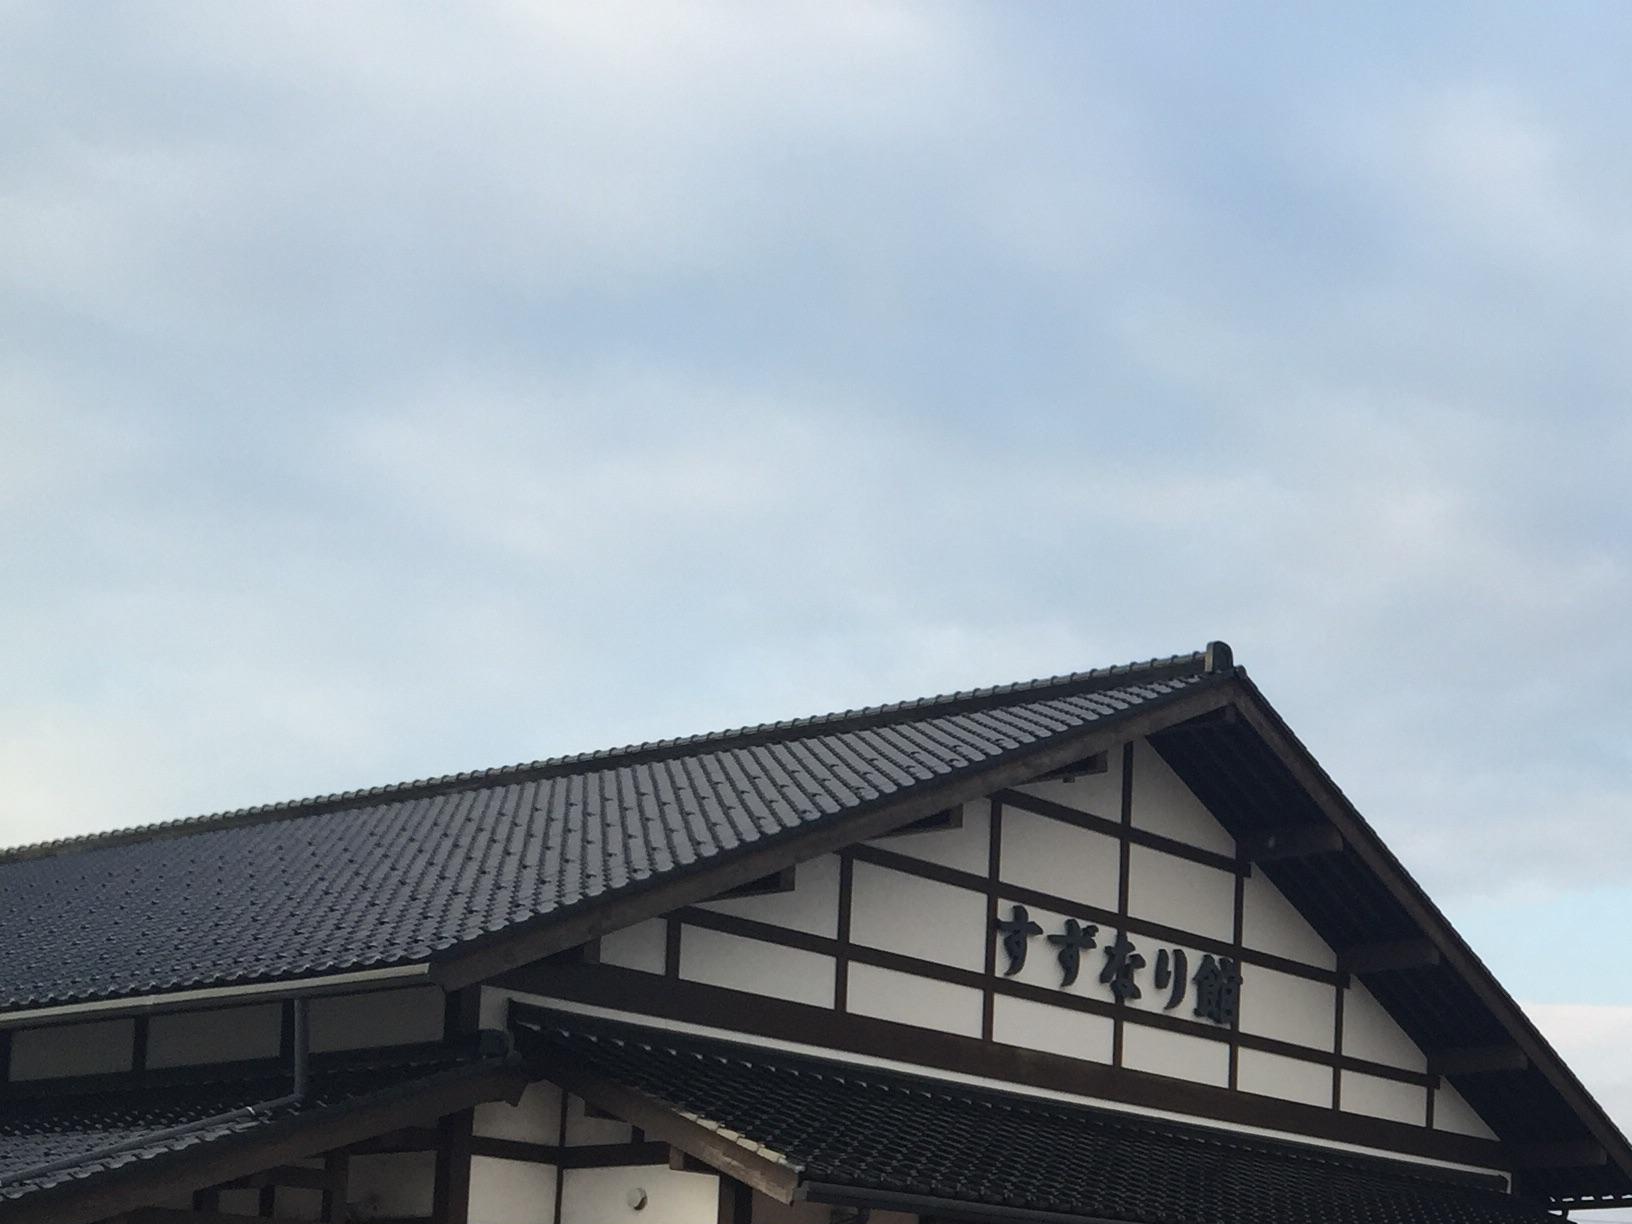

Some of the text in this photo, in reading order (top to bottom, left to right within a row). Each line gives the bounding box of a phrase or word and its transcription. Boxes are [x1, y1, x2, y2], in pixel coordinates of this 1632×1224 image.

[997, 905, 1243, 1024] すずなり館
